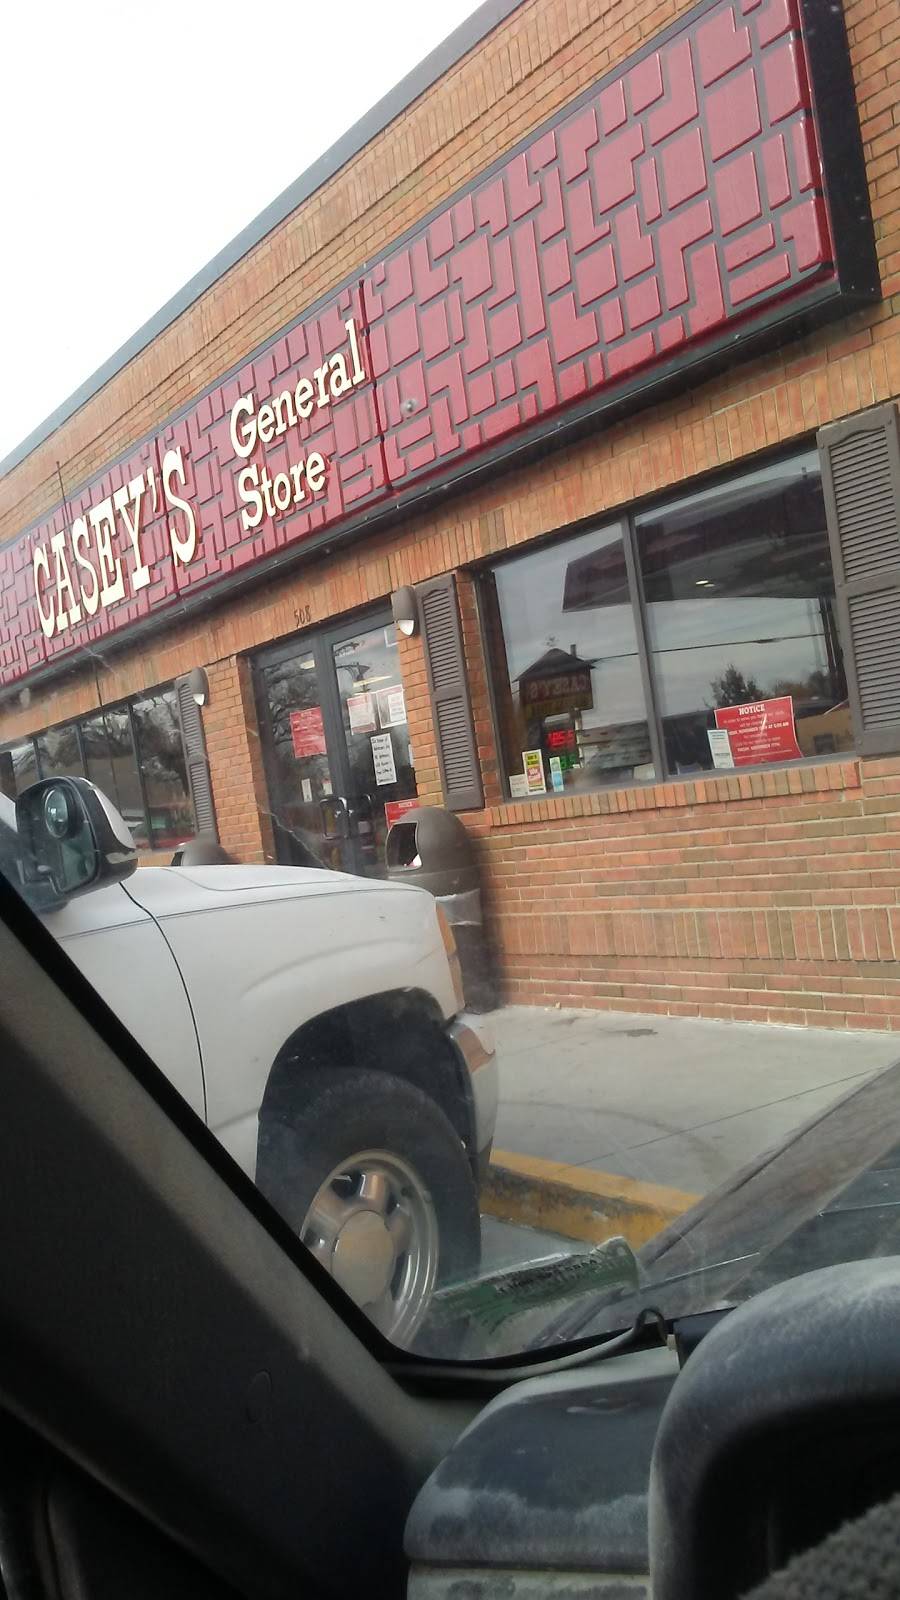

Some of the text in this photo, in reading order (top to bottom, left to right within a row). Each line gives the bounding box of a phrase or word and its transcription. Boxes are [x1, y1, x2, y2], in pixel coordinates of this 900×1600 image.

[230, 318, 366, 459] General
[237, 452, 326, 531] Store
[33, 446, 198, 638] CASEY'S
[293, 604, 311, 628] 508
[738, 703, 766, 716] NOTICE
